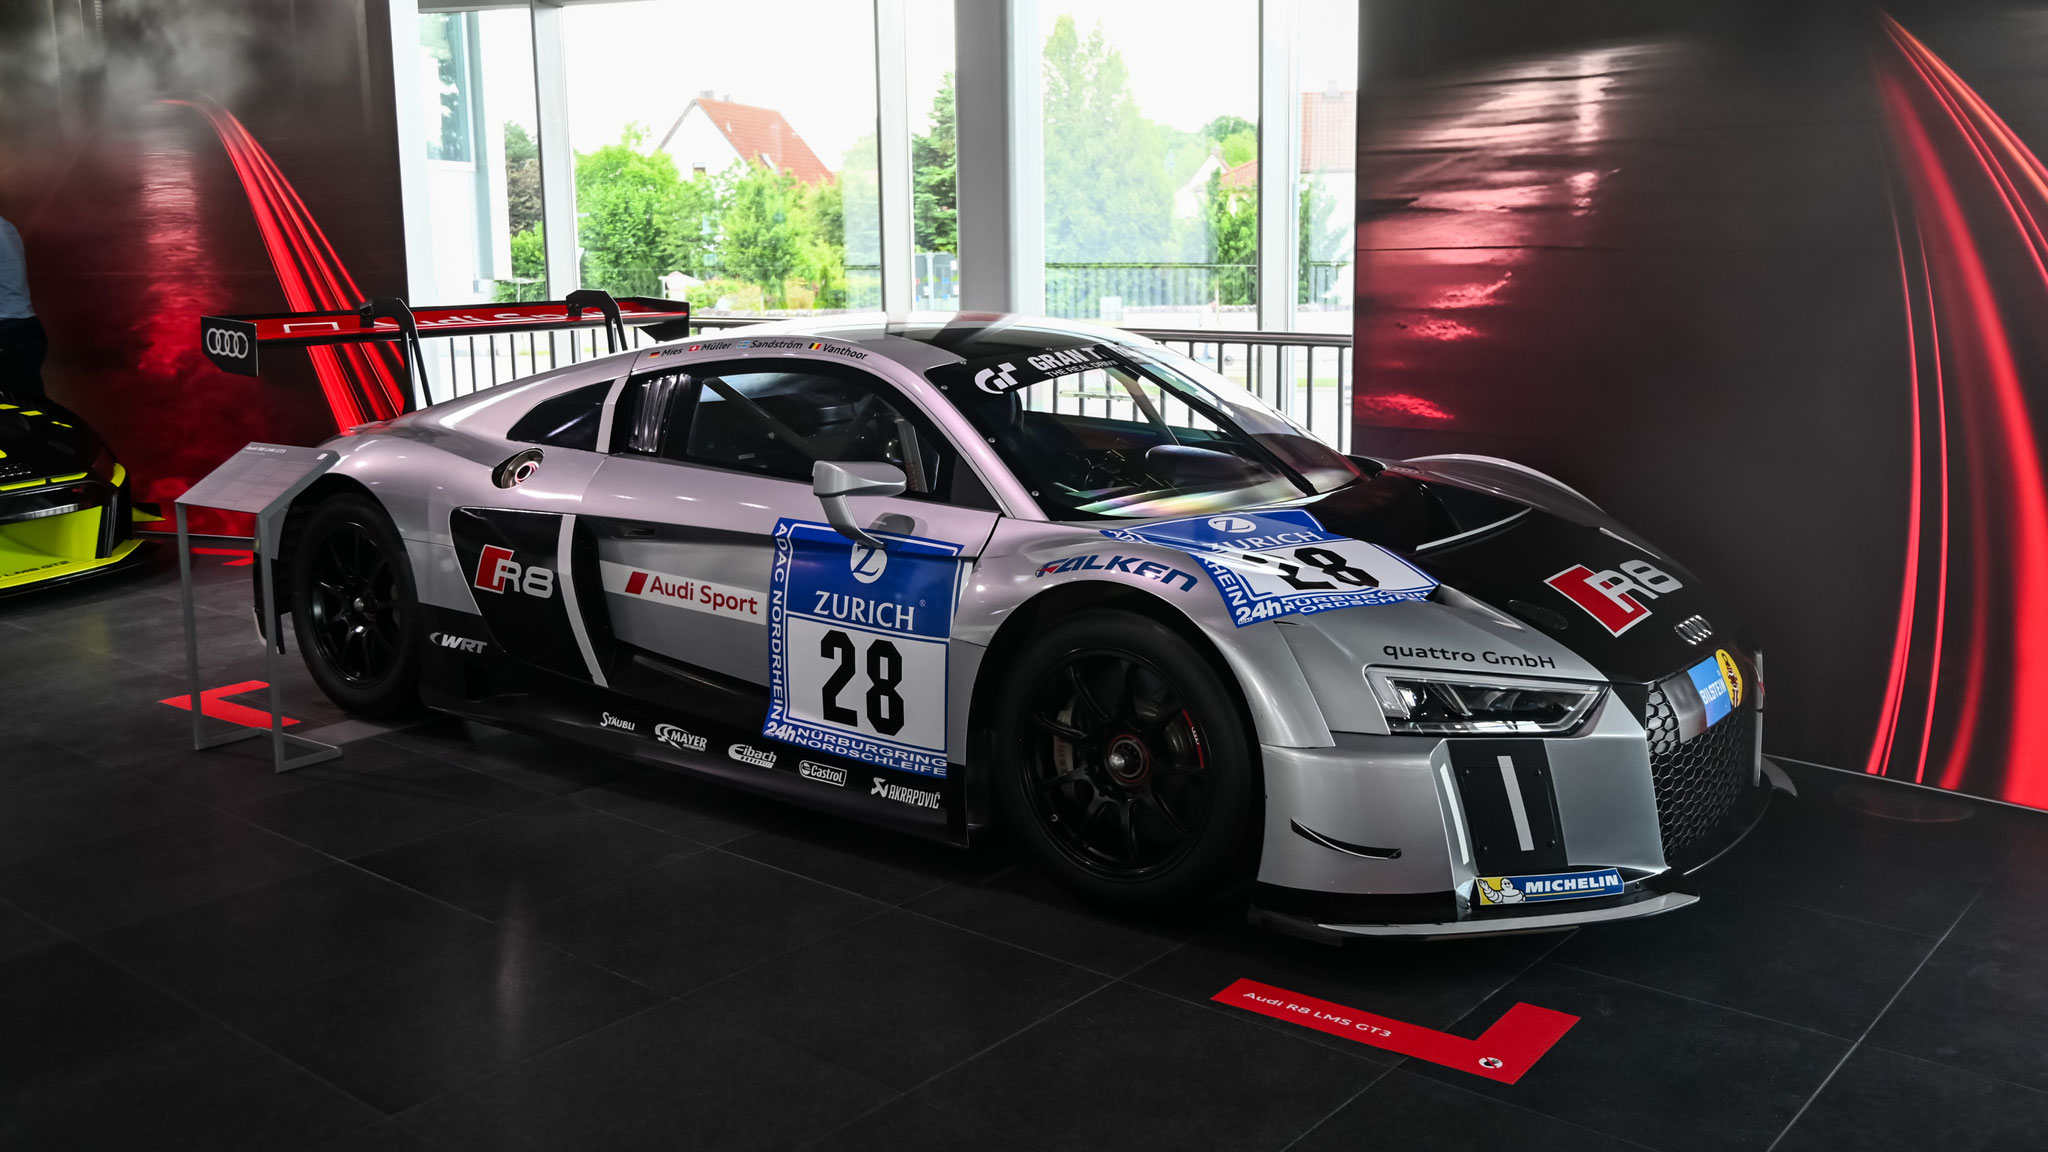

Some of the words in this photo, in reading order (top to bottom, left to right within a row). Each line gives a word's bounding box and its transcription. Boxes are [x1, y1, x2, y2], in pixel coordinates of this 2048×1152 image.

[661, 347, 683, 357] Mies
[701, 341, 733, 351] Müller
[750, 339, 803, 350] Sandström
[822, 343, 868, 361] Vanthoor
[1027, 349, 1090, 371] GRAN
[1044, 369, 1069, 378] THE
[1066, 363, 1093, 373] REAL
[774, 522, 789, 583] ADAC
[1035, 554, 1199, 593] FALKEN
[650, 576, 694, 601] Audi
[700, 585, 758, 615] Sport
[813, 590, 916, 632] ZURICH
[1236, 600, 1282, 624] 24h
[441, 633, 488, 654] WRT
[770, 589, 784, 720] NORDRHEIN
[1382, 644, 1475, 662] quattro
[1482, 650, 1556, 670] GmbH
[820, 629, 905, 737] 28
[1699, 677, 1727, 705] BILSTEIN
[670, 730, 708, 749] MAYER
[728, 743, 777, 763] Eibach
[764, 721, 796, 742] 24h
[797, 727, 948, 767] NÜRBURGRING
[795, 736, 947, 776] NORDSCHLEIFE
[810, 764, 843, 783] Castrol
[1525, 874, 1619, 894] MICHELIN
[1243, 992, 1285, 1007] Audi
[1286, 1003, 1311, 1014] R8
[1313, 1011, 1353, 1026] LMS
[1355, 1023, 1392, 1037] GT3
